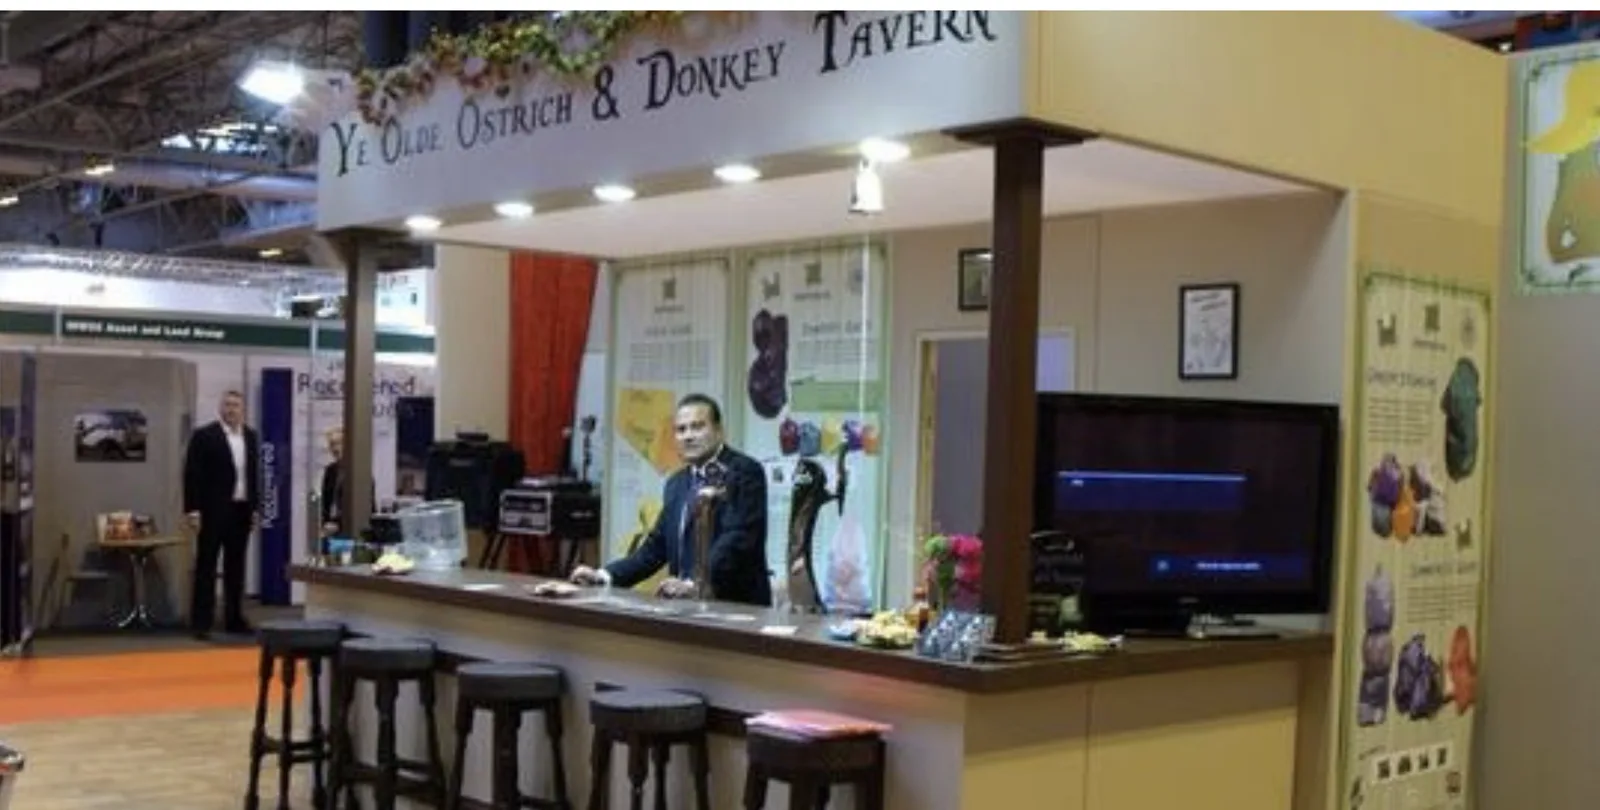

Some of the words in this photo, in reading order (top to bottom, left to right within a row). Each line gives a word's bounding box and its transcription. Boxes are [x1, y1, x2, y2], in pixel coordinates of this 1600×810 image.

[456, 93, 572, 149] OSTRICH
[592, 65, 620, 121] &
[637, 41, 786, 111] DONKEY
[813, 10, 998, 73] TAVERN
